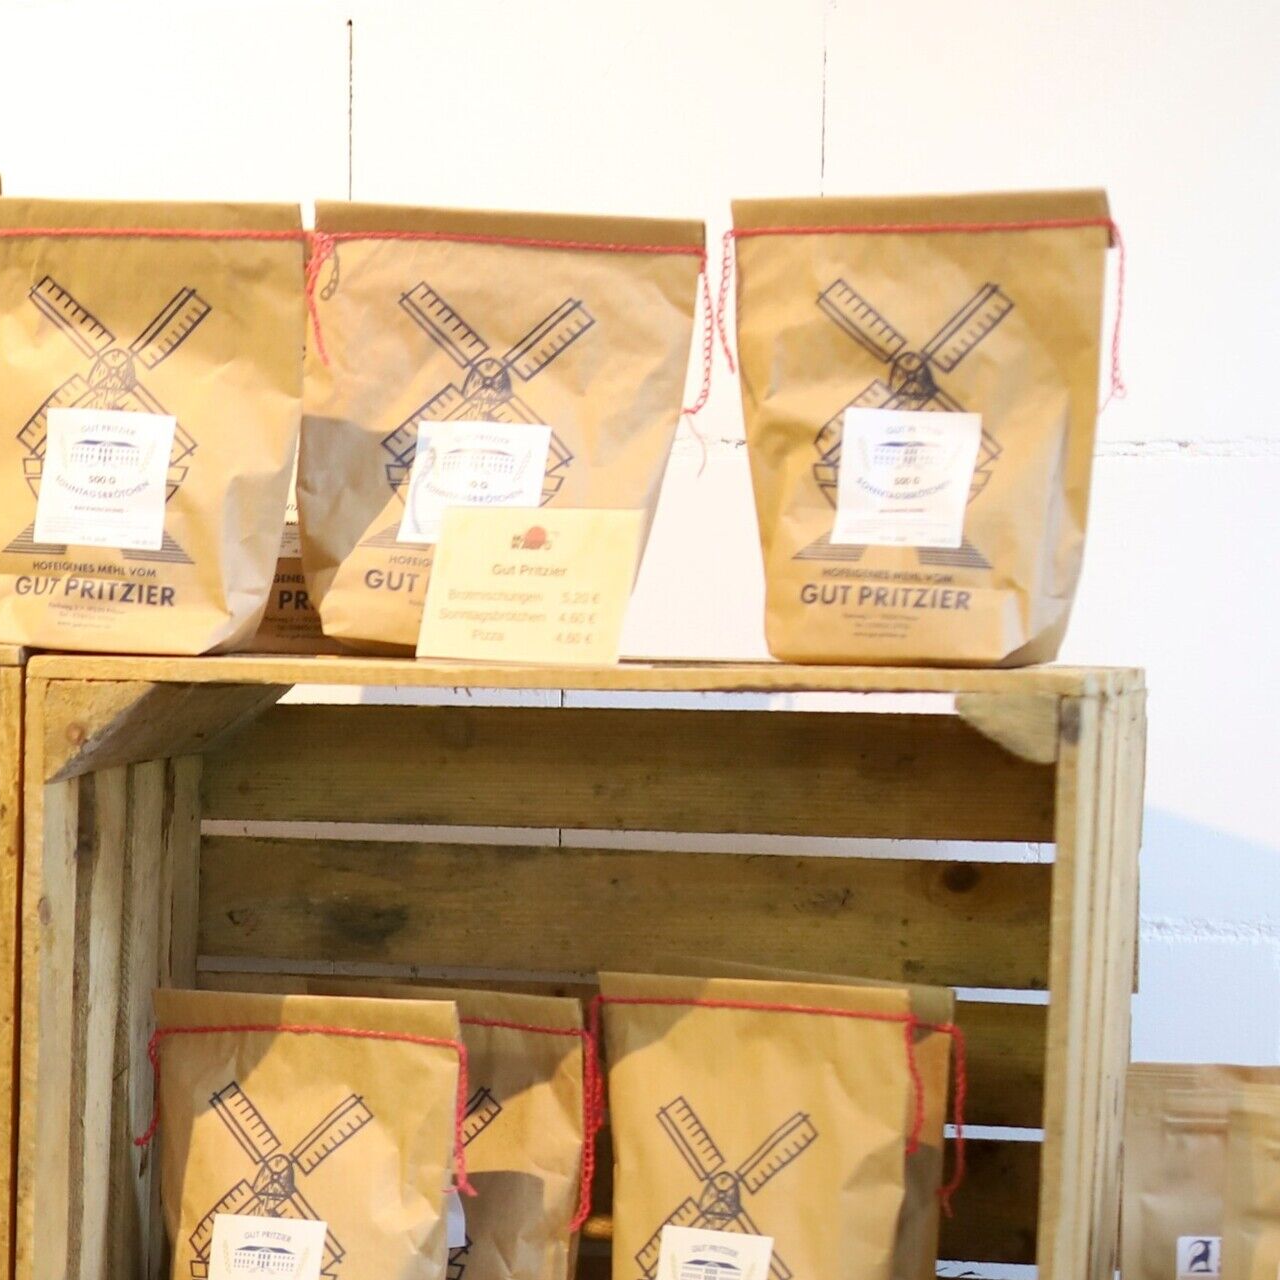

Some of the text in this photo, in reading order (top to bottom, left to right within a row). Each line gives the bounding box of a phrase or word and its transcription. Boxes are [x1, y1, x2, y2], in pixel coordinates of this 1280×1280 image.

[33, 561, 156, 578] HOFEIGENES MEHL VOM
[492, 564, 568, 577] Gut Pritzier
[15, 576, 176, 607] GUT PRITZIER
[364, 570, 420, 592] GUT
[800, 584, 971, 611] GUT PRITZIER
